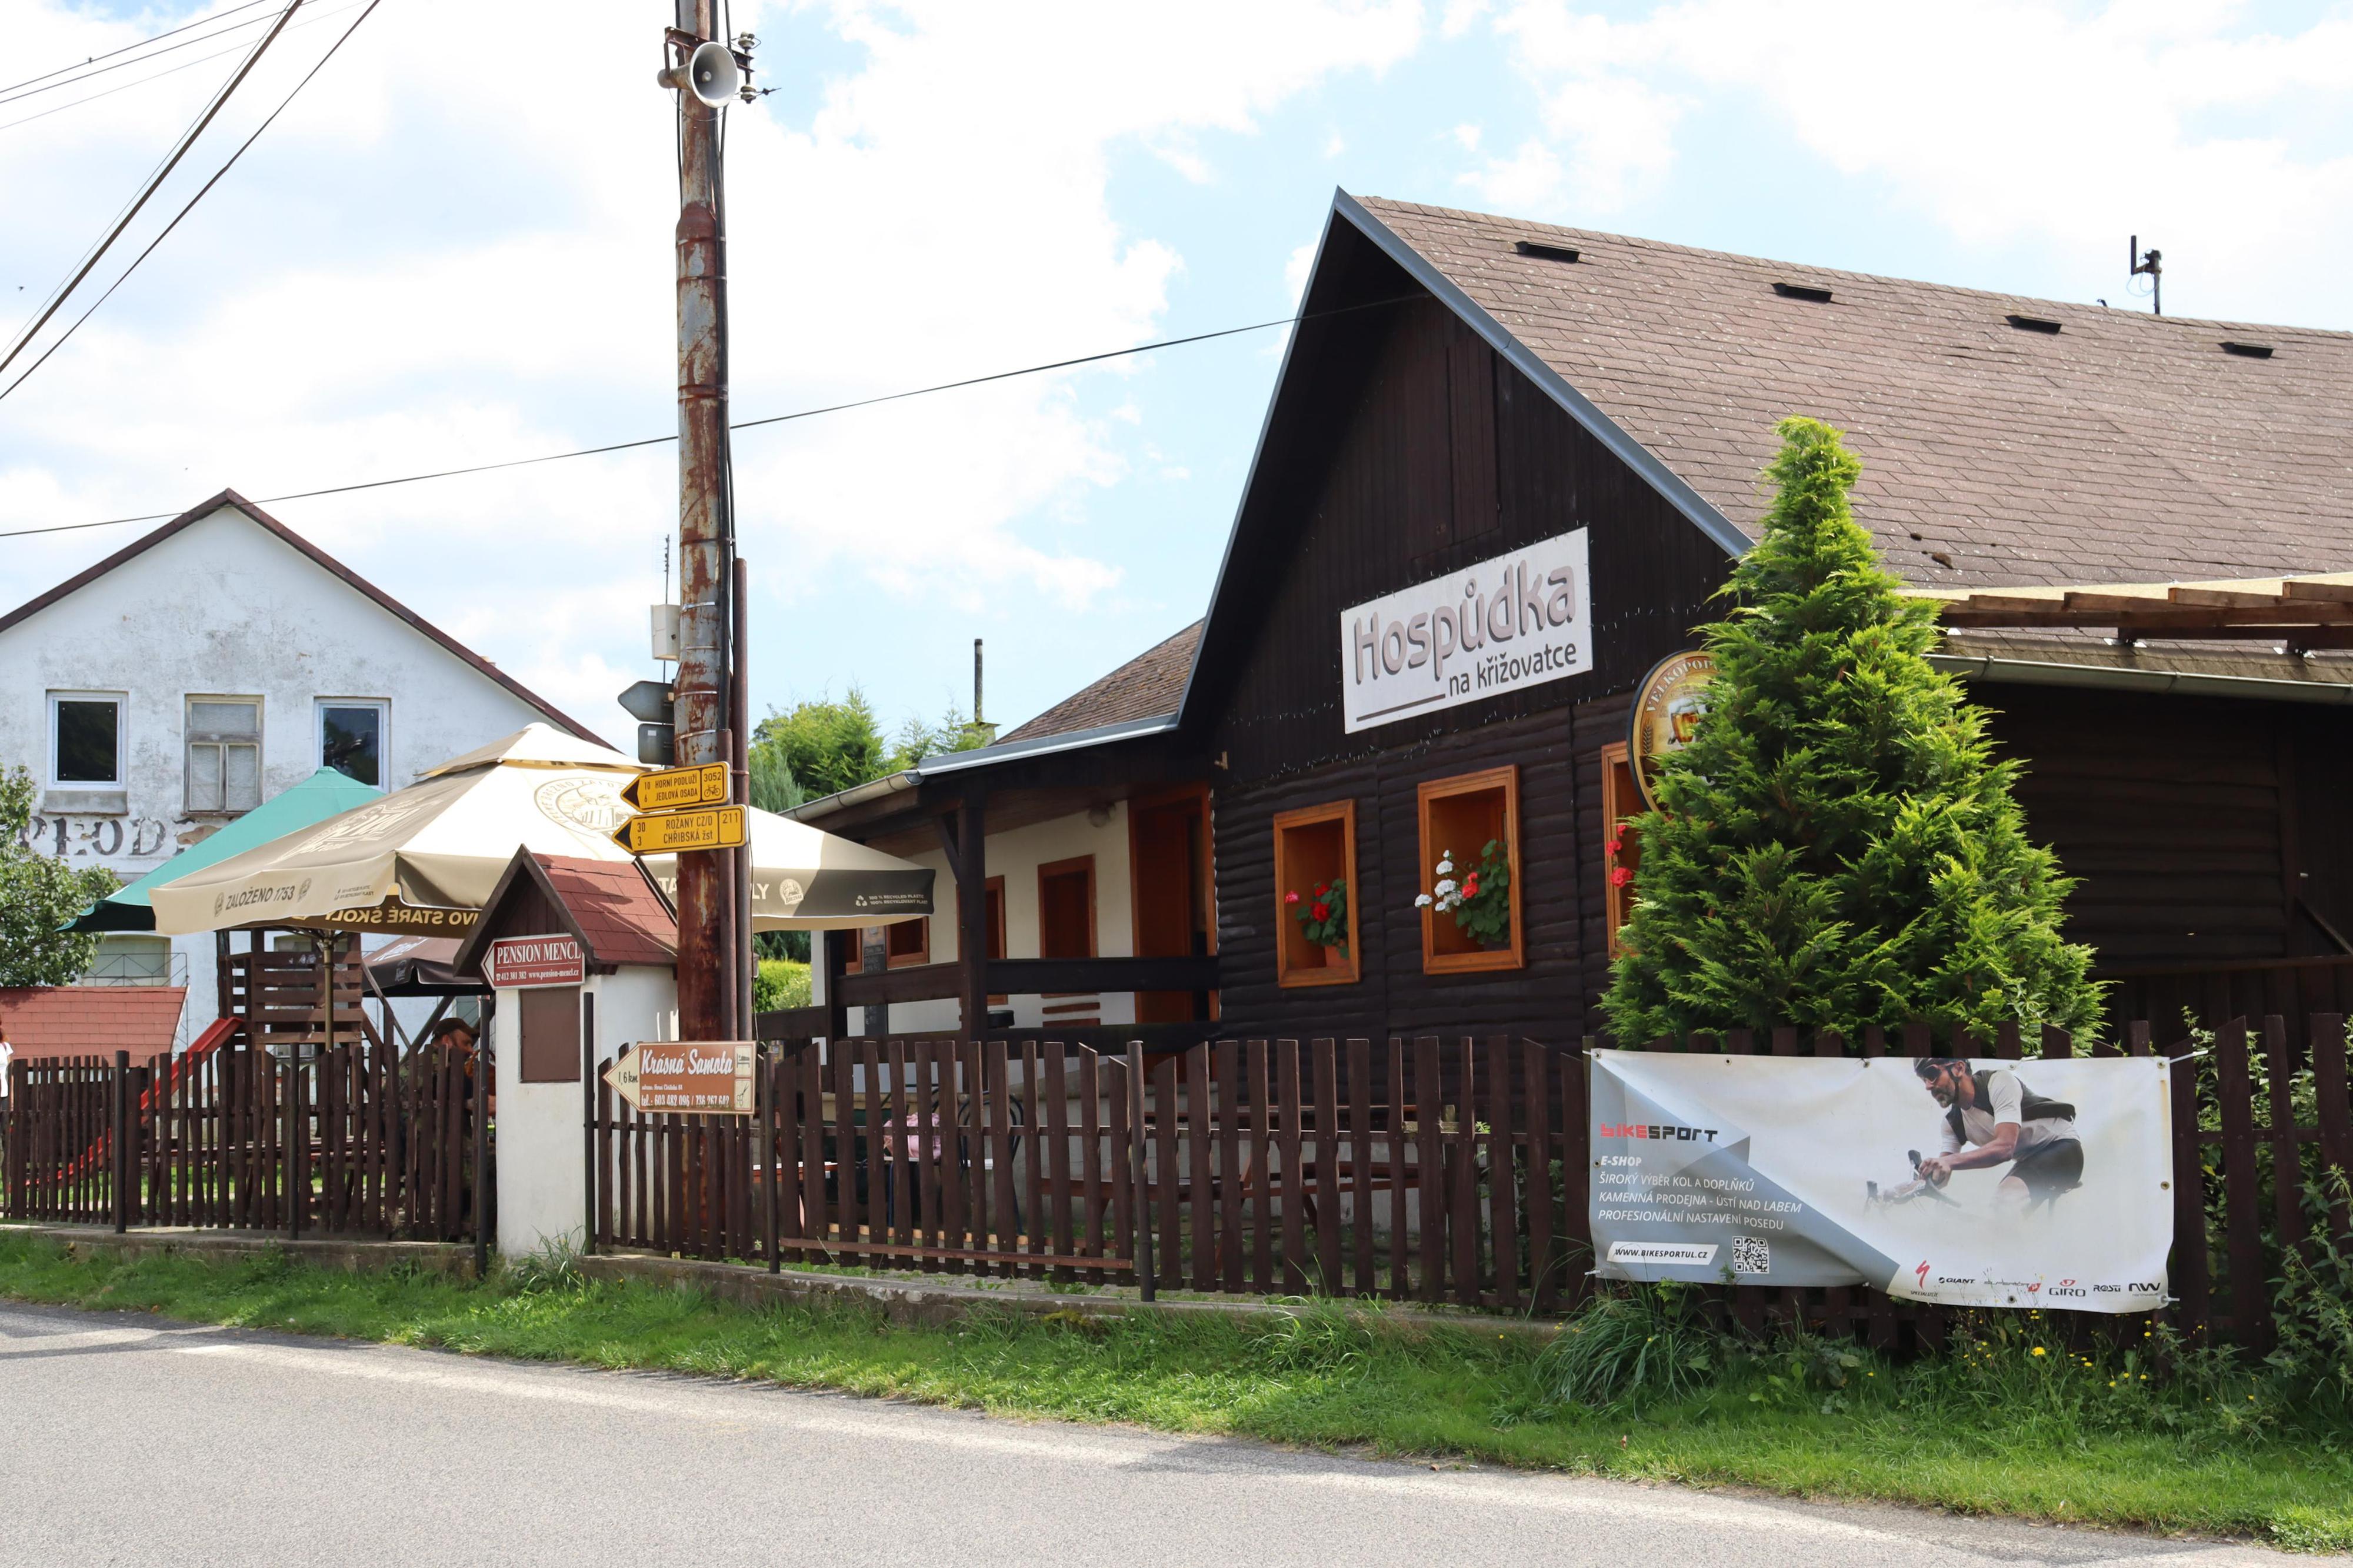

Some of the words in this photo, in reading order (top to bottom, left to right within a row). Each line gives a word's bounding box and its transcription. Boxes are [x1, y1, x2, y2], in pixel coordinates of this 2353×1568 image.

[1355, 560, 1576, 685] Hospůdka
[1449, 673, 1470, 697] na
[1477, 643, 1577, 689] křižovatce
[644, 781, 651, 790] 10
[655, 776, 673, 789] HORNÍ
[674, 773, 698, 785] PODLUŽÍ
[704, 772, 721, 782] 3052
[655, 789, 678, 802] JEDLOVÁ
[680, 788, 698, 798] OSADA
[637, 822, 646, 833] 30
[666, 816, 694, 830] ROŽANY
[696, 815, 713, 827] CZ/D
[722, 813, 739, 824] 211
[638, 836, 642, 846] 3
[664, 828, 700, 844] CHŘIBSKÁ
[702, 830, 713, 840] žst
[225, 887, 274, 910] ZALOŽENO
[273, 885, 295, 902] 1753
[496, 944, 542, 965] PENSION
[543, 940, 581, 961] MENCL
[501, 972, 509, 980] 412
[528, 968, 579, 980] www.pension-mencl.cz
[641, 1049, 685, 1075] Krásná
[688, 1048, 734, 1075] Samota
[628, 1071, 638, 1083] km
[655, 1094, 665, 1106] 603
[666, 1095, 678, 1106] 482
[679, 1095, 690, 1107] 096
[1600, 1156, 1642, 1167] E-SHOP
[1599, 1171, 1639, 1185] ŠIROKÝ
[1641, 1173, 1670, 1186] VÝBĚR
[1672, 1176, 1692, 1187] KOL
[1695, 1178, 1702, 1187] A
[1704, 1177, 1755, 1192] DOPLŇKŮ
[1599, 1190, 1653, 1203] KAMENNÁ
[1656, 1193, 1707, 1207] PRODEJNA
[1717, 1195, 1737, 1207] ÚSTÍ
[1739, 1199, 1761, 1210] NAD
[1764, 1200, 1802, 1213] LABEM
[1598, 1209, 1684, 1223] PROFESIONÁLNÍ
[1687, 1212, 1741, 1225] NASTAVENÍ
[1744, 1216, 1784, 1230] POSEDU
[1615, 1249, 1708, 1259] WWW.BIKESPORTUL.CZ
[2049, 1287, 2086, 1297] GIRO
